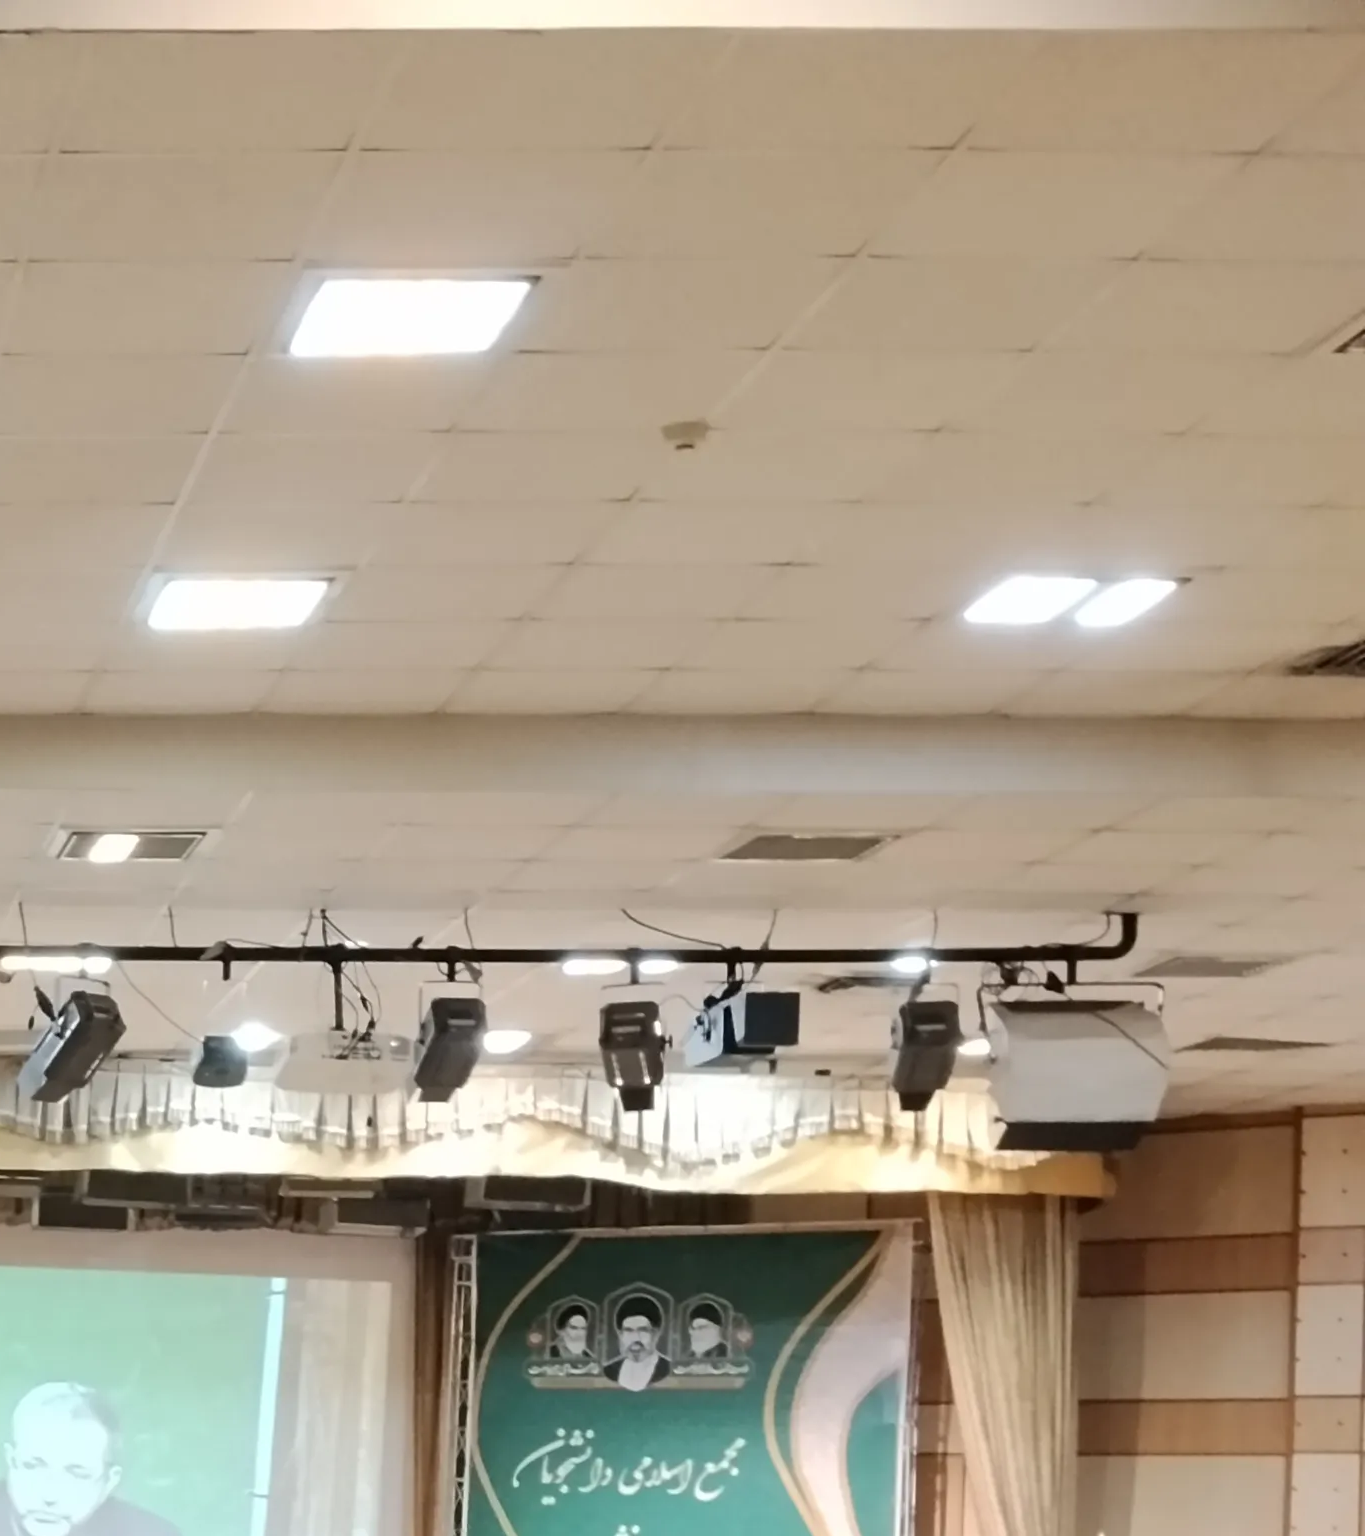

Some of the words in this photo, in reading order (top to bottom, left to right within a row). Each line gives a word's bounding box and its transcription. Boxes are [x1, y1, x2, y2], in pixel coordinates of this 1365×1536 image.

[512, 1427, 614, 1506] دانشجویان
[618, 1456, 694, 1496] اسلامی
[694, 1437, 746, 1502] مجمع
